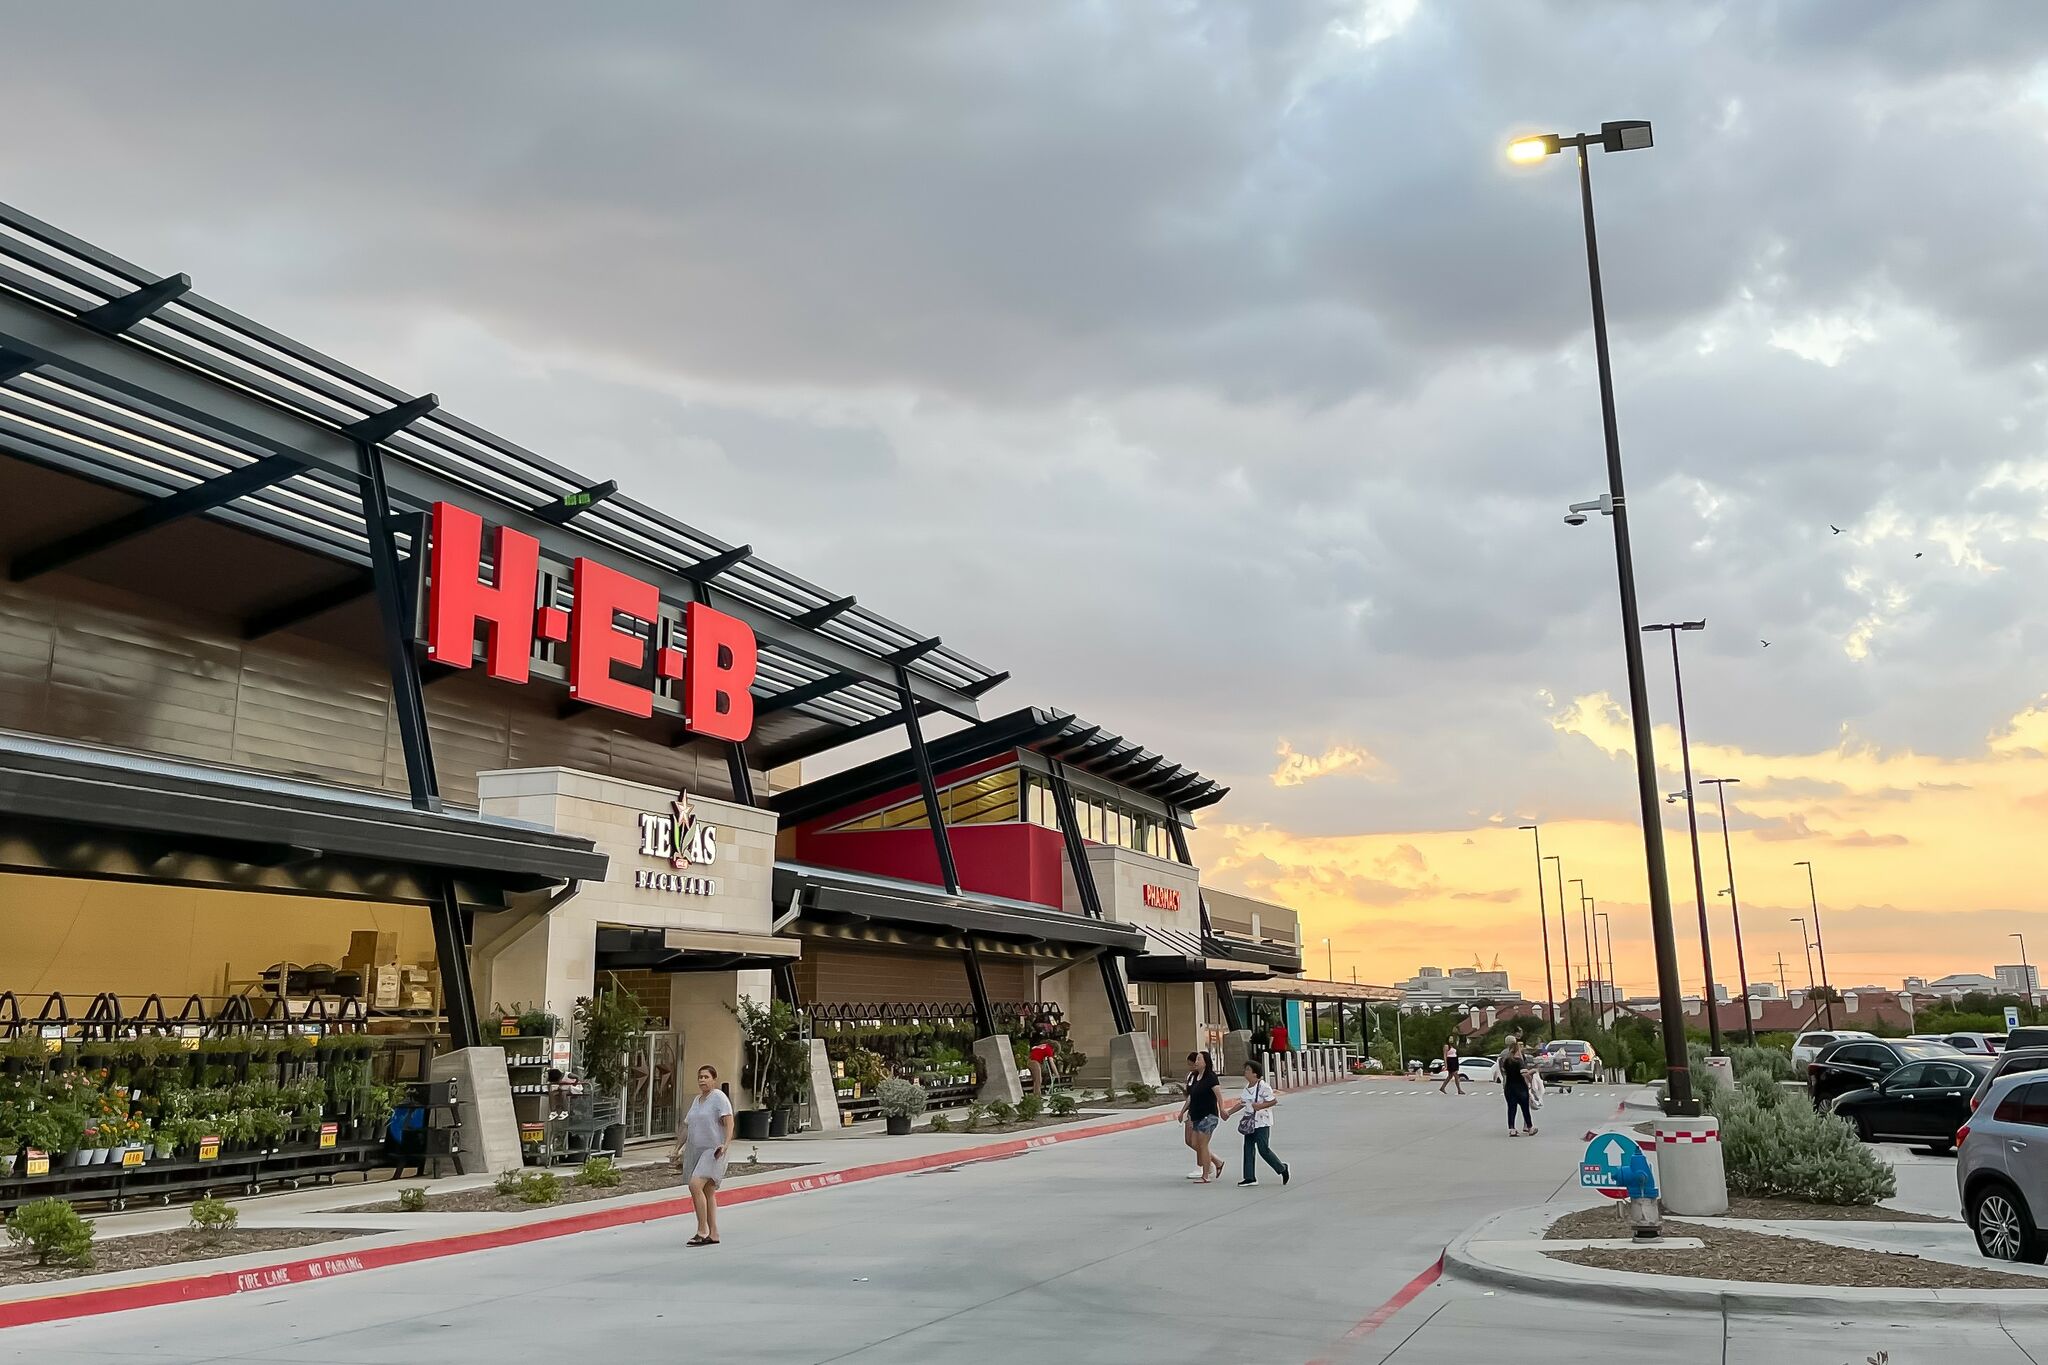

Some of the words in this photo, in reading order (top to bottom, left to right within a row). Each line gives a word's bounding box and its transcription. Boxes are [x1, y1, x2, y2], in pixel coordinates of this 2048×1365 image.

[640, 813, 717, 865] TEXAS
[637, 871, 716, 897] BACKYARD
[1144, 884, 1181, 912] PHARMACY
[237, 1273, 262, 1291] FIRE
[264, 1267, 290, 1286] LANE
[308, 1263, 322, 1277] NO
[325, 1256, 363, 1274] PARKING
